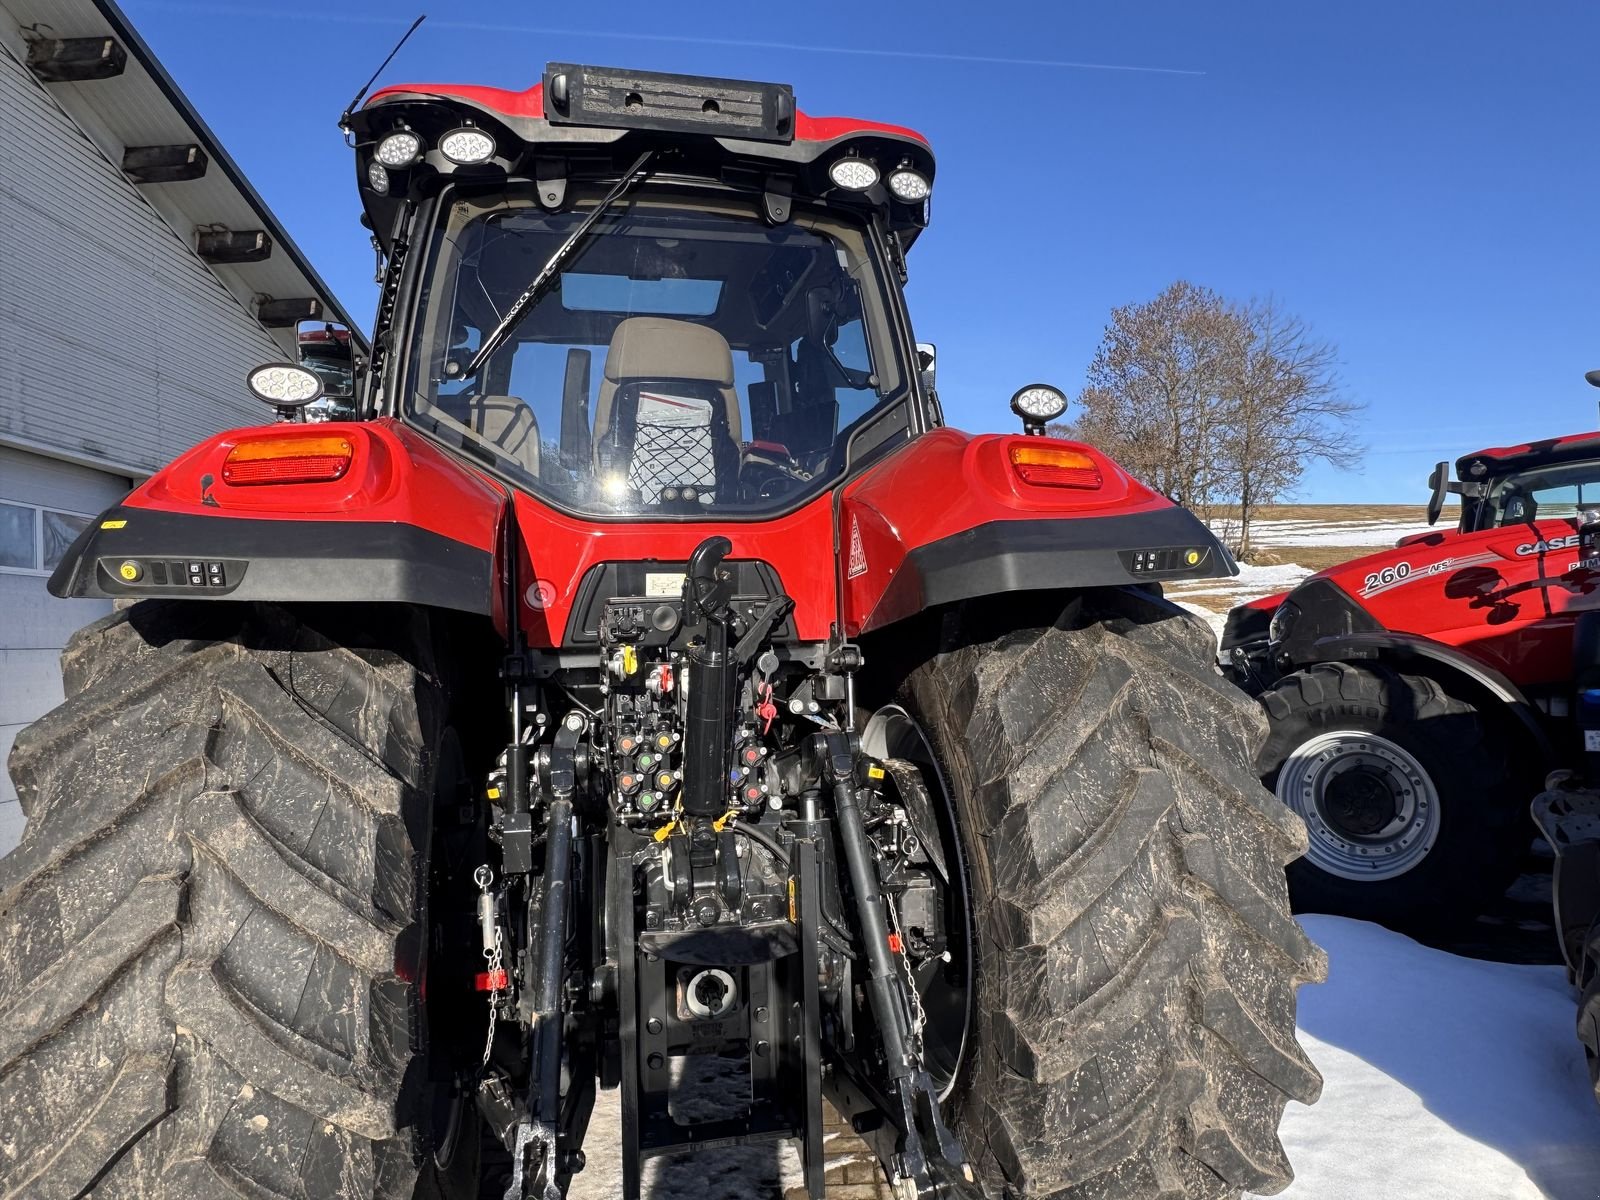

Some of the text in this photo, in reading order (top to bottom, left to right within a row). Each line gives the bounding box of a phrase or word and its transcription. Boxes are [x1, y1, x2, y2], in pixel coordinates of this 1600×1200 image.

[1515, 534, 1580, 556] CASE
[1568, 557, 1600, 572] PUM
[1364, 560, 1448, 592] 260 AFS
